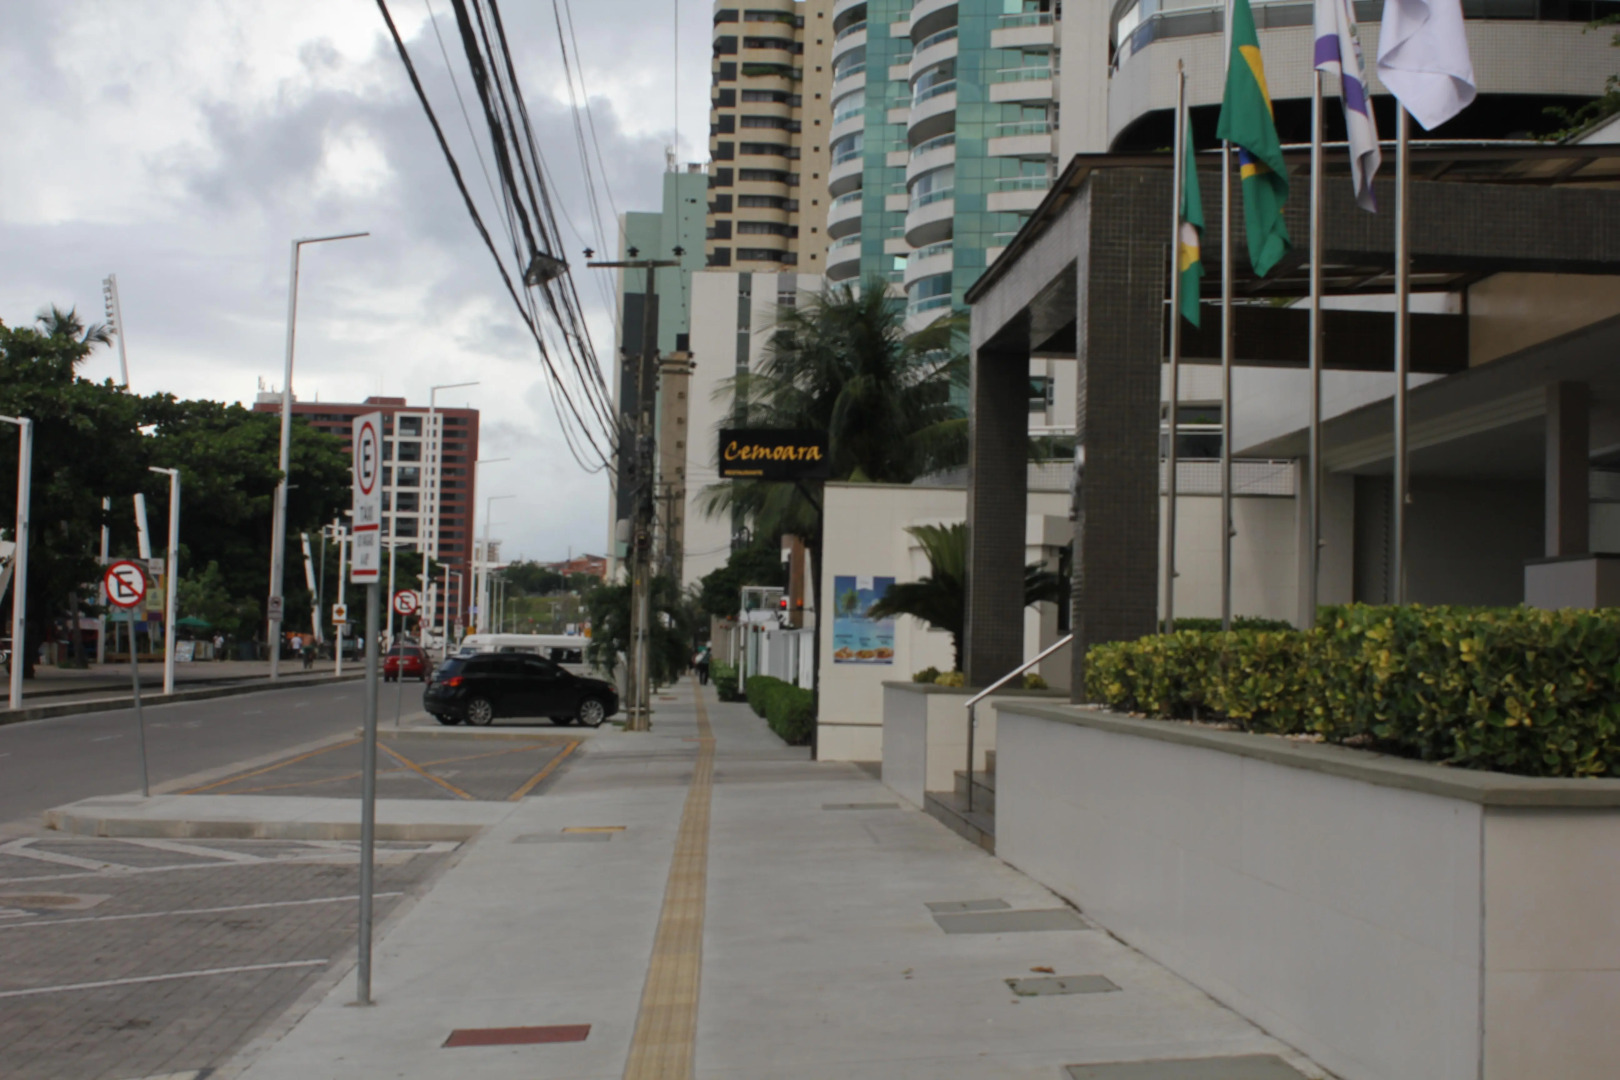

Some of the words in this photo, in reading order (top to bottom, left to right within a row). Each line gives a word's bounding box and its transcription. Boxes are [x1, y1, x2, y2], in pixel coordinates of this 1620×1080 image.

[363, 440, 371, 478] E
[724, 441, 822, 461] Cemoara
[116, 571, 136, 597] E
